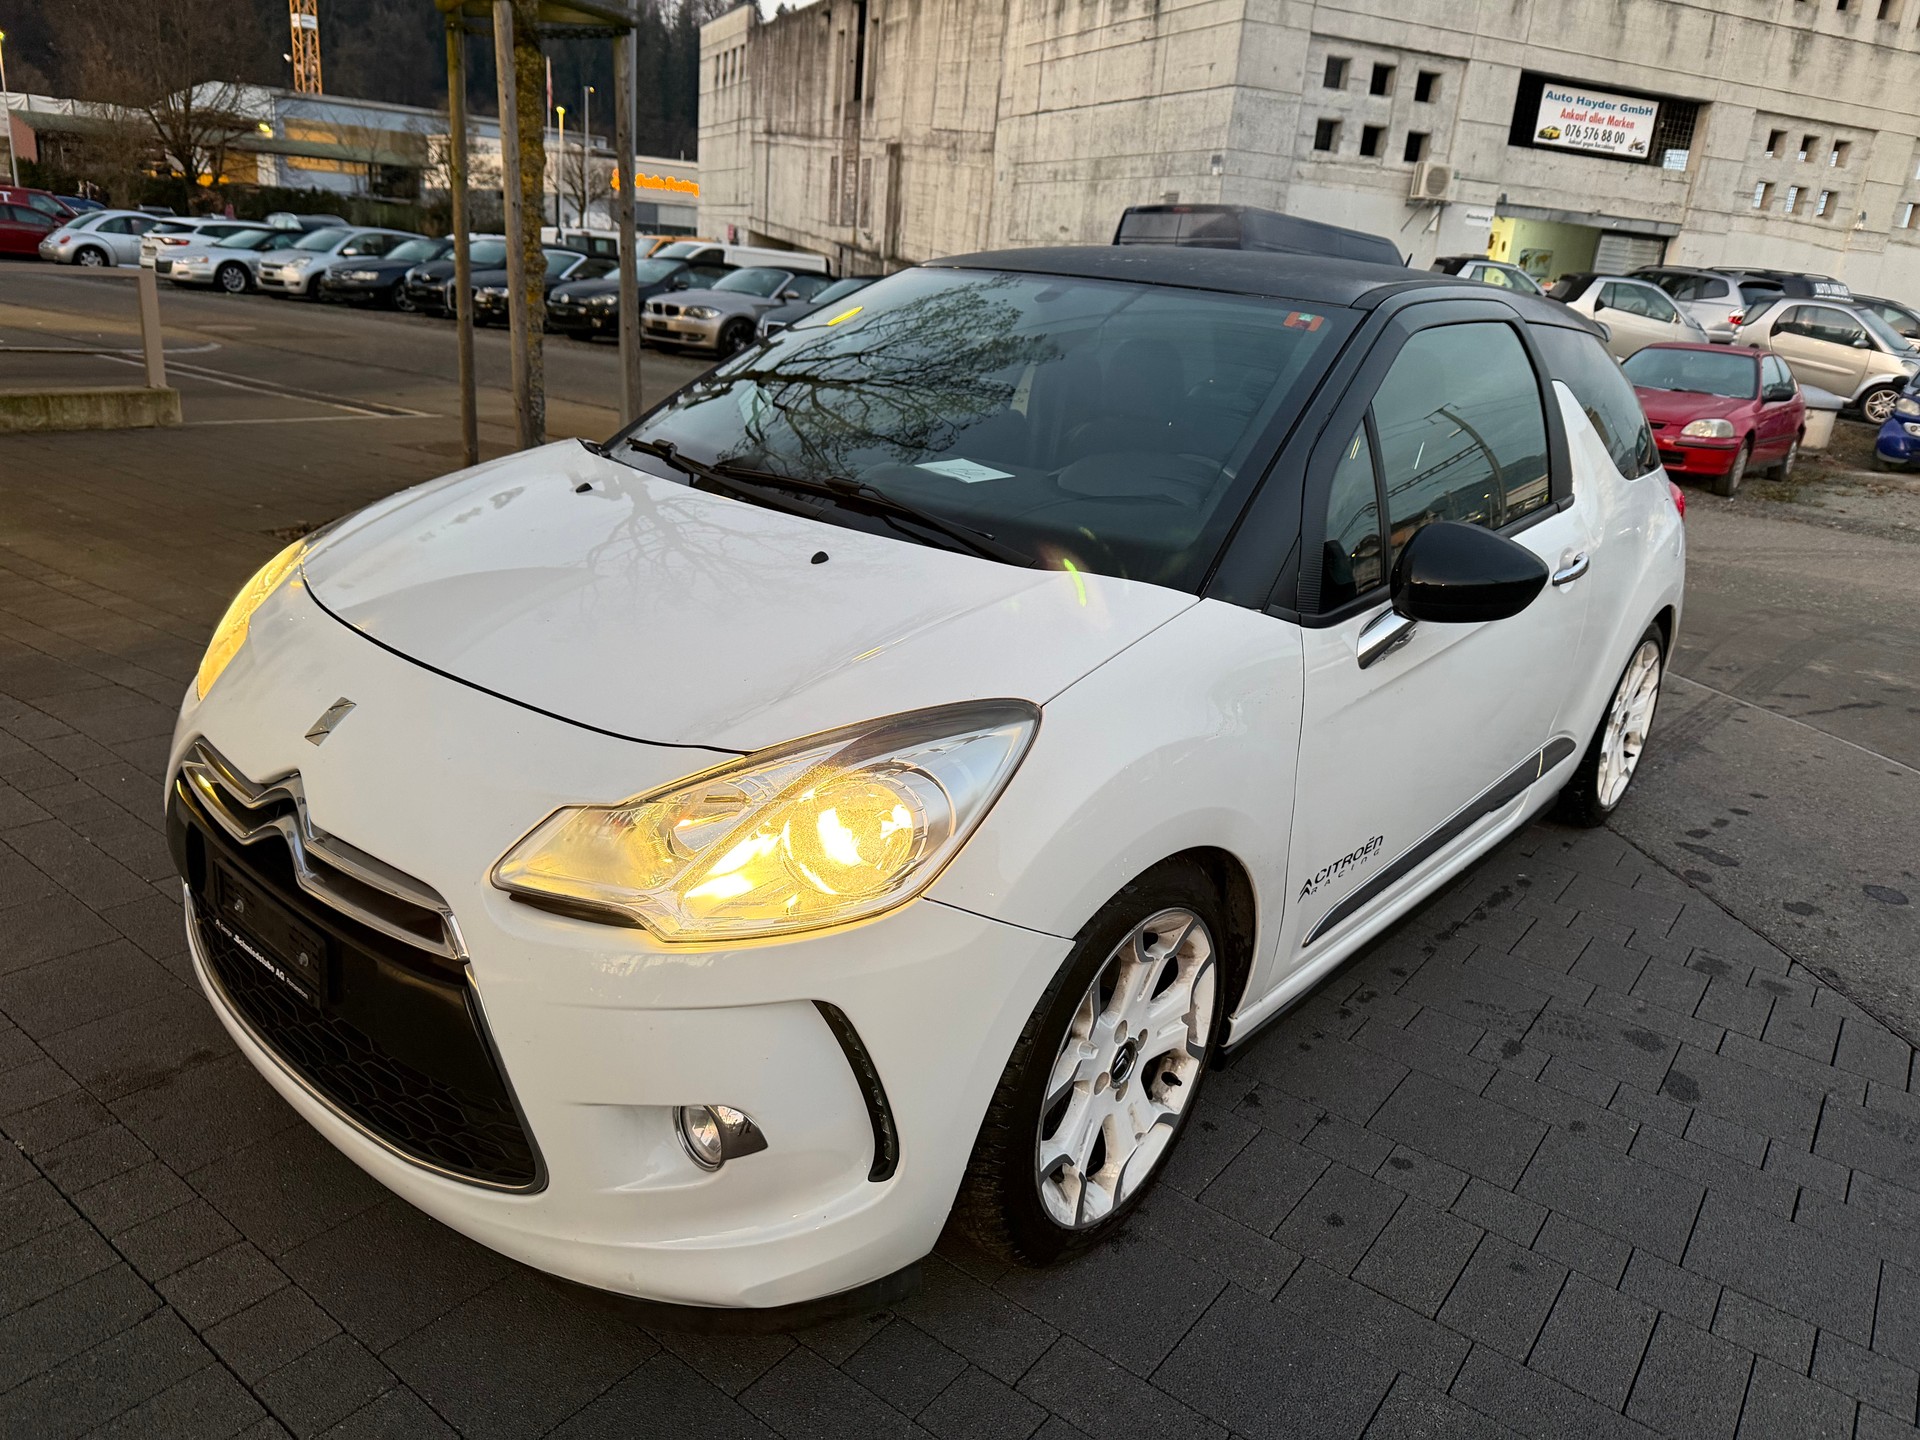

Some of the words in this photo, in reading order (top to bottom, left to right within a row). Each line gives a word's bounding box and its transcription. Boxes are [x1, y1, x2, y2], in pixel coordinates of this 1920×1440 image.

[1546, 90, 1572, 103] Auto
[1576, 96, 1616, 110] Hayder
[1620, 103, 1653, 116] GmbH
[1560, 108, 1588, 121] Ankauf
[1589, 112, 1605, 124] aller
[1607, 115, 1635, 129] Marken
[1565, 124, 1581, 138] 076
[1583, 127, 1599, 140] 576
[1601, 130, 1612, 143] 88
[1614, 131, 1625, 144] 00
